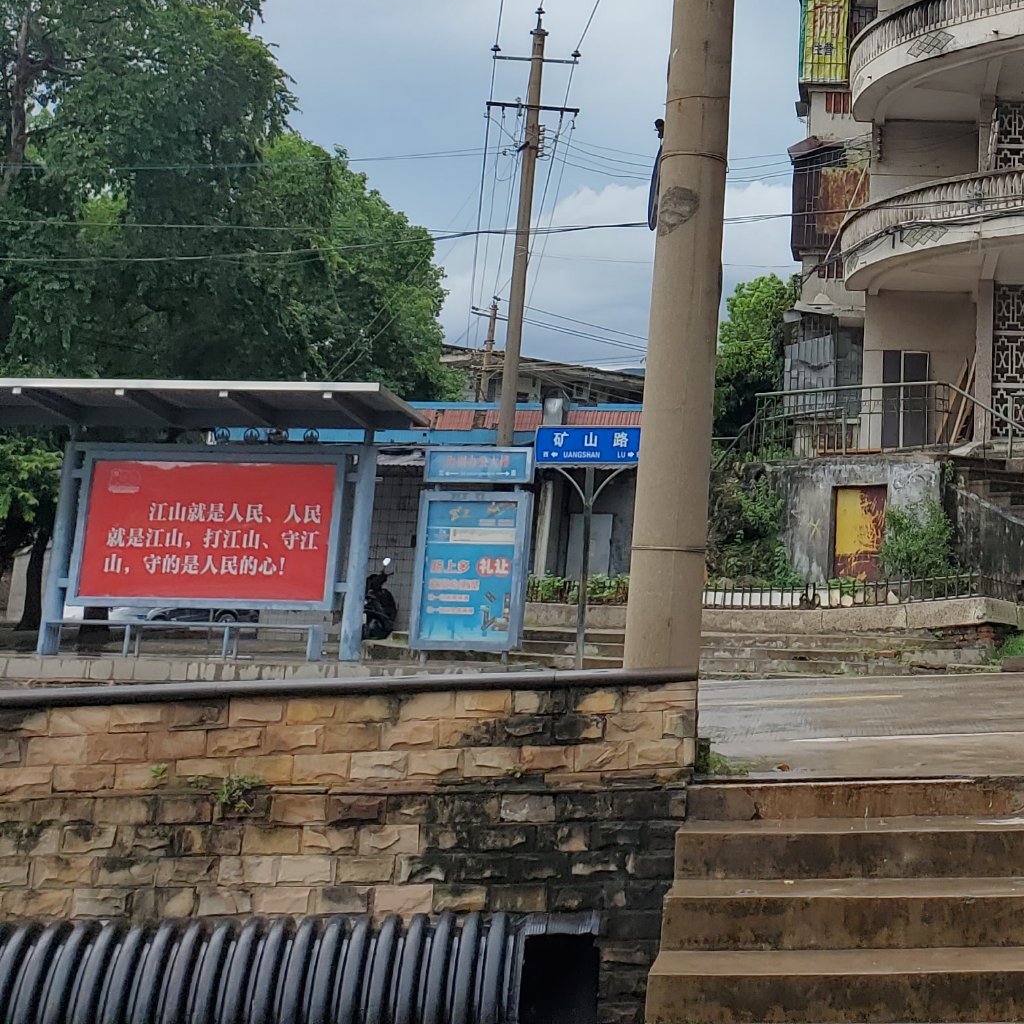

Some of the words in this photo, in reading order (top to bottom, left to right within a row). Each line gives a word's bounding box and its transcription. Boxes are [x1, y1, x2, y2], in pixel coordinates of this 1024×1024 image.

[553, 431, 629, 448] 矿山路
[149, 502, 321, 524] 江山就是人民、人民
[106, 527, 320, 550] 就是江山，打江山、守江
